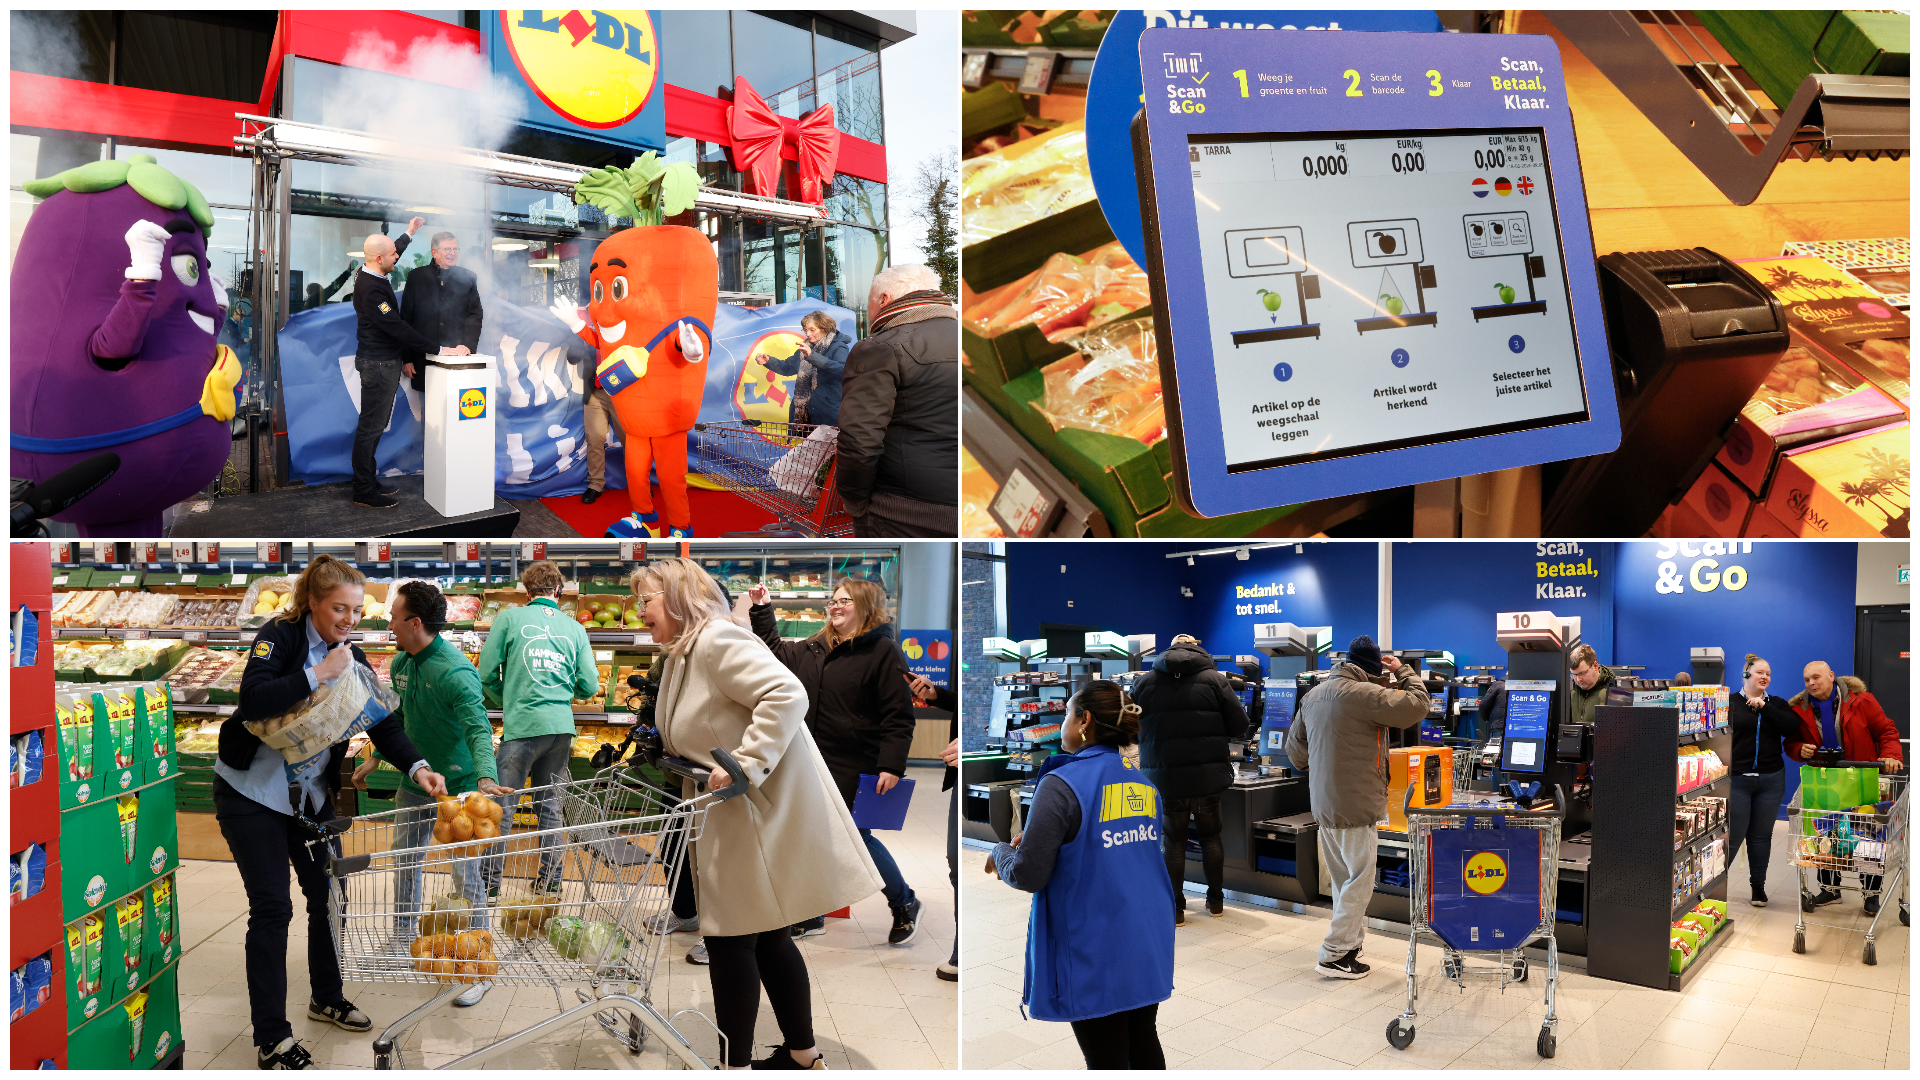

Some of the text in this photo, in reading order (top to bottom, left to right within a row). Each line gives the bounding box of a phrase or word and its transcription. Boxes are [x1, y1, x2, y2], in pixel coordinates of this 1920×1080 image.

[1500, 57, 1544, 74] Scan,
[1233, 69, 1249, 98] 1
[1258, 73, 1293, 84] Weeg je
[1343, 69, 1363, 97] 2
[1370, 73, 1402, 82] Scan de
[1425, 69, 1444, 97] 3
[1452, 80, 1471, 88] Klaar
[1491, 76, 1547, 92] Betaal,
[1167, 84, 1206, 98] Scan
[1260, 86, 1328, 97] groente en fruit
[1372, 86, 1405, 95] barcode
[1504, 95, 1550, 110] Klaar.
[1336, 142, 1345, 152] kg
[1397, 139, 1422, 150] EUR/kg
[1489, 136, 1502, 146] EUR
[1204, 146, 1231, 155] TARRA
[1303, 155, 1348, 178] 0,000
[1392, 152, 1425, 175] 0,00
[1474, 149, 1505, 171] 0,00
[1513, 340, 1520, 349] 3
[1397, 354, 1404, 363] 2
[1492, 367, 1551, 382] Selecteer het
[1373, 381, 1438, 398] Artikel wordt
[1496, 379, 1552, 397] juiste artikel
[1252, 397, 1321, 414] Artikel op de
[1387, 397, 1428, 411] herkend
[1257, 411, 1320, 428] weegschaal
[1271, 429, 1309, 442] leggen
[175, 548, 190, 558] 1.49
[1536, 558, 1598, 578] Betaal,
[1236, 582, 1296, 598] Bedankt &
[1536, 582, 1587, 600] Klaar.
[1236, 600, 1282, 615] tot snel.
[1512, 613, 1531, 629] 10
[1266, 625, 1276, 637] 11
[989, 639, 996, 648] 13
[1093, 634, 1101, 644] 12
[533, 658, 541, 667] IN
[1511, 694, 1547, 702] Scan & Go
